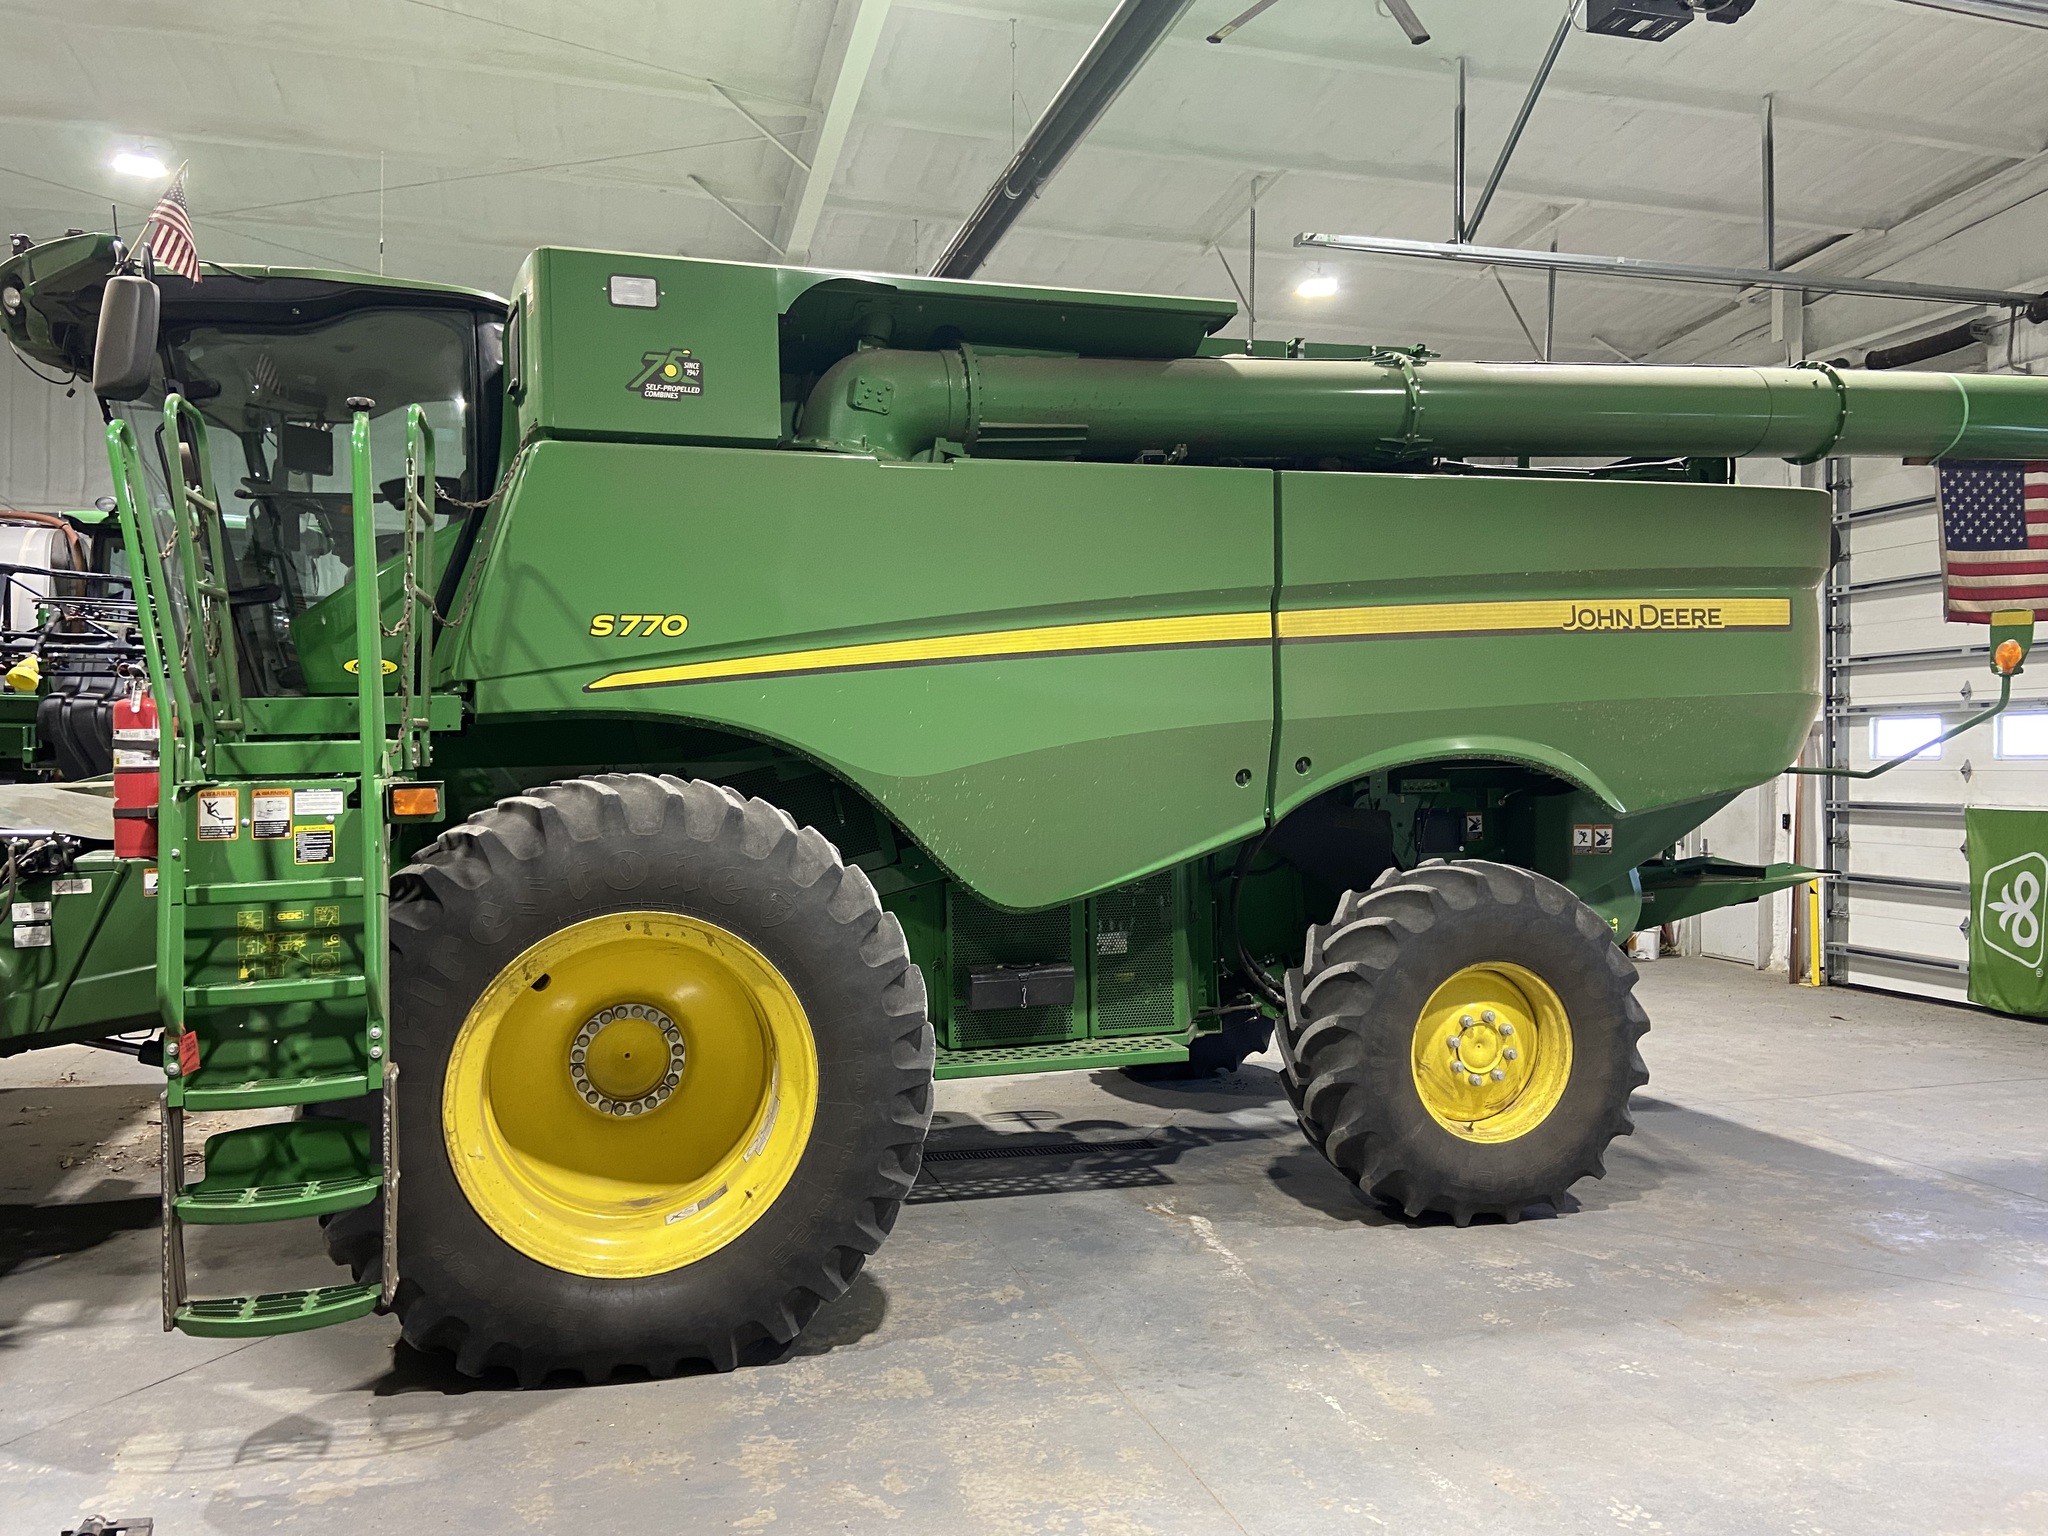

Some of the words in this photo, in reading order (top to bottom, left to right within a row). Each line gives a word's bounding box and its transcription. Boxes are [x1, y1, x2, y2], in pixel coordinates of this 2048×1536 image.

[645, 383, 700, 393] SELF-PROPELLED
[589, 613, 689, 637] S770
[1563, 604, 1633, 628] JOHN
[1639, 604, 1722, 626] DEERE
